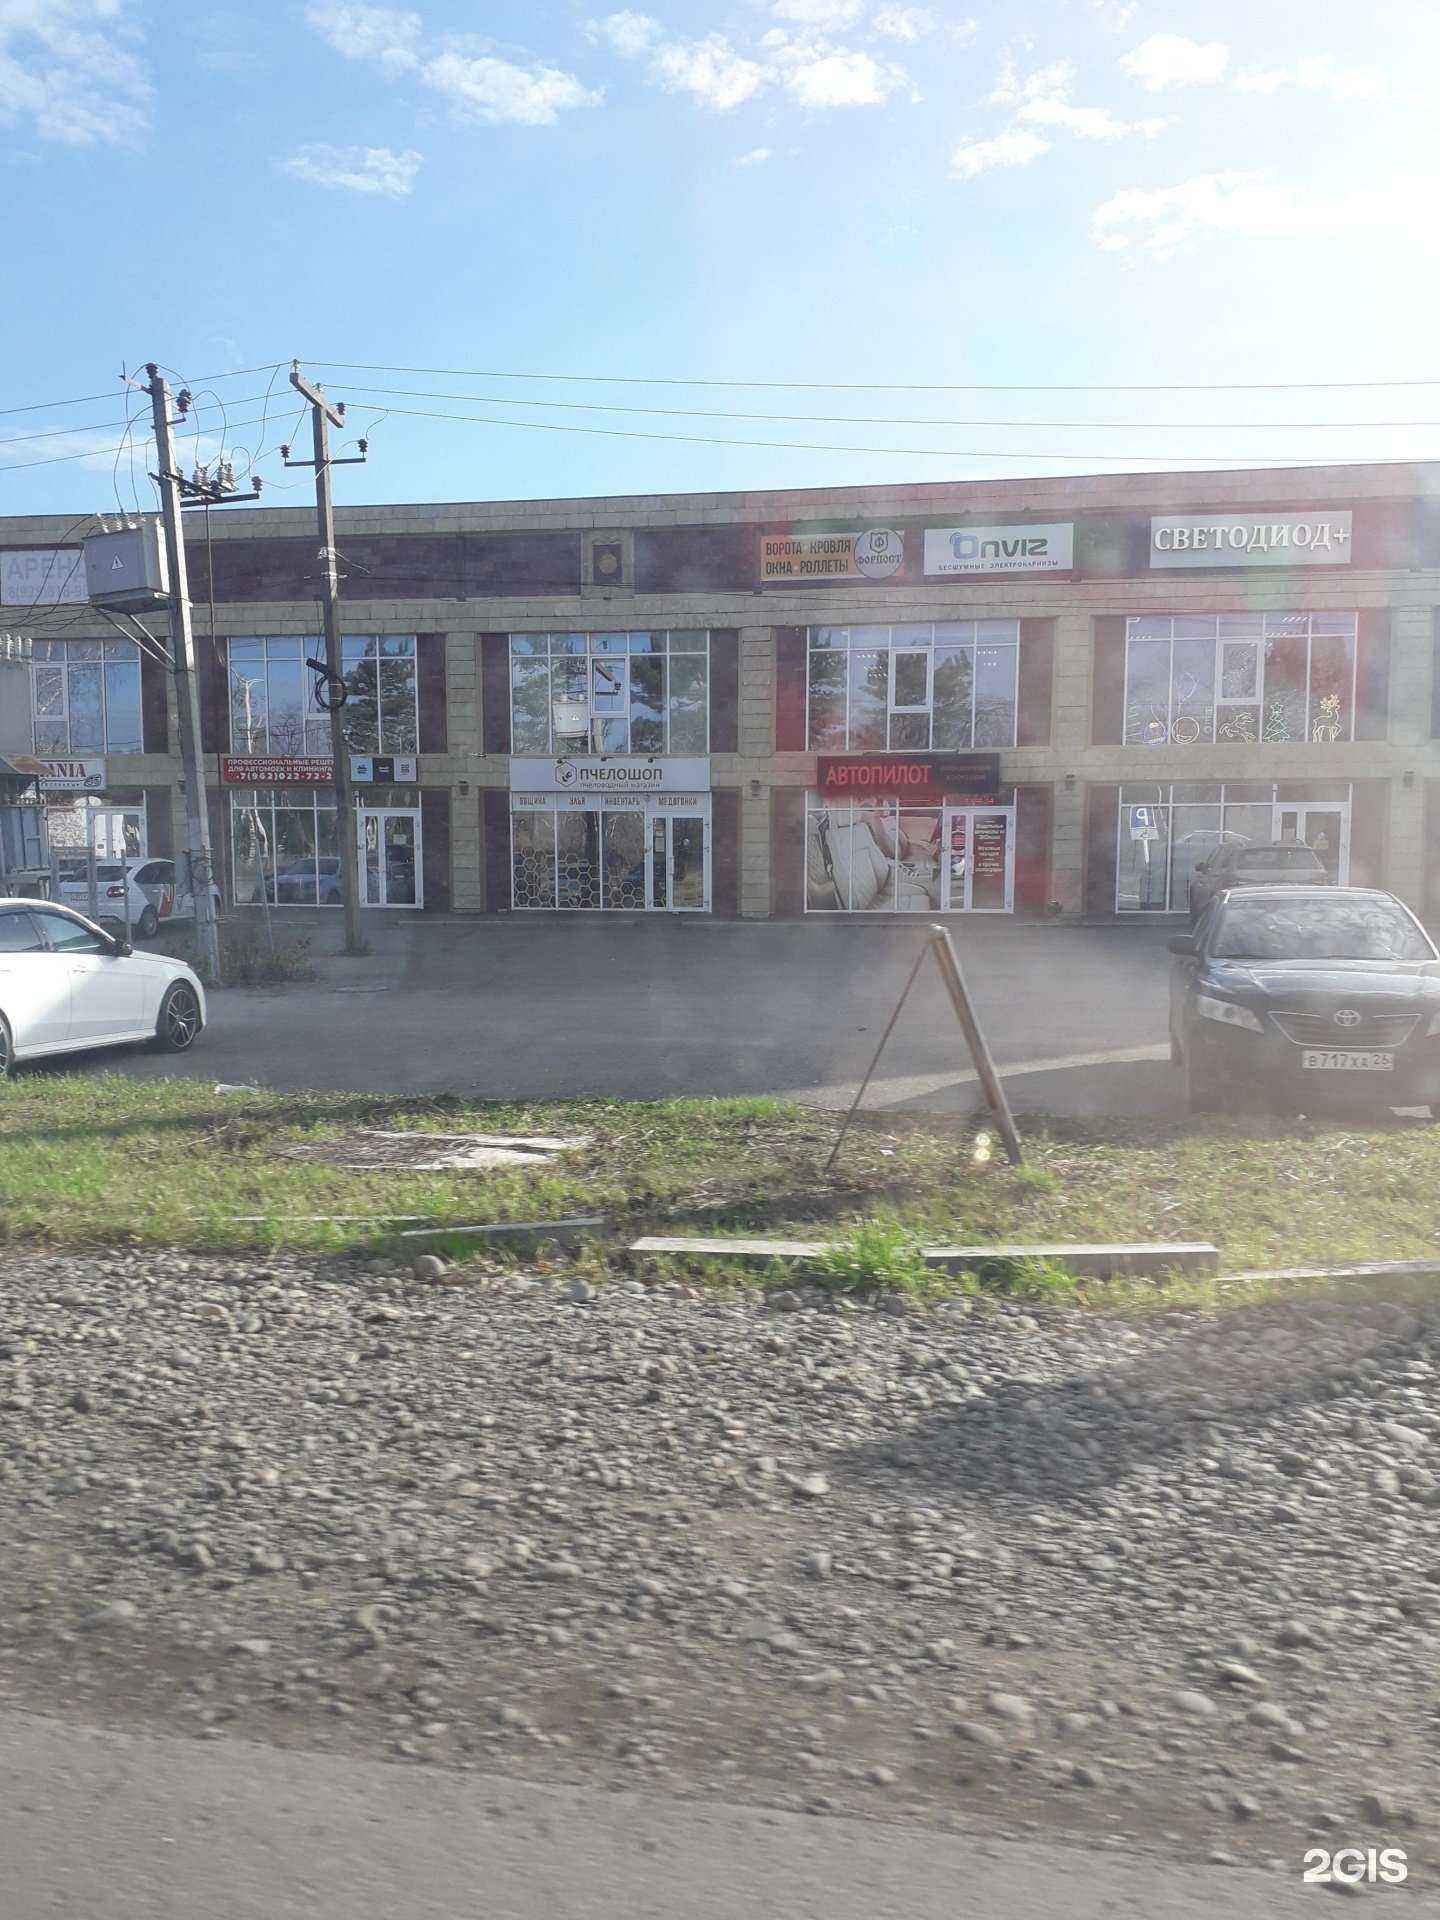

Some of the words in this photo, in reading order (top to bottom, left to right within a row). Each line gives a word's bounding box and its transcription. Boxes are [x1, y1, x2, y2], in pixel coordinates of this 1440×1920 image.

[1154, 523, 1350, 552] СВЕТОДИОД+
[766, 542, 802, 556] ВОРОТА
[810, 539, 851, 554] КРОВЛЯ
[766, 561, 793, 575] ОКНА
[800, 560, 848, 573] РОЛЛЕТЫ
[858, 554, 902, 565] ФОРПОСТ
[580, 768, 663, 781] ПЧЕЛОШОП
[825, 765, 932, 785] АВТОПИЛОТ
